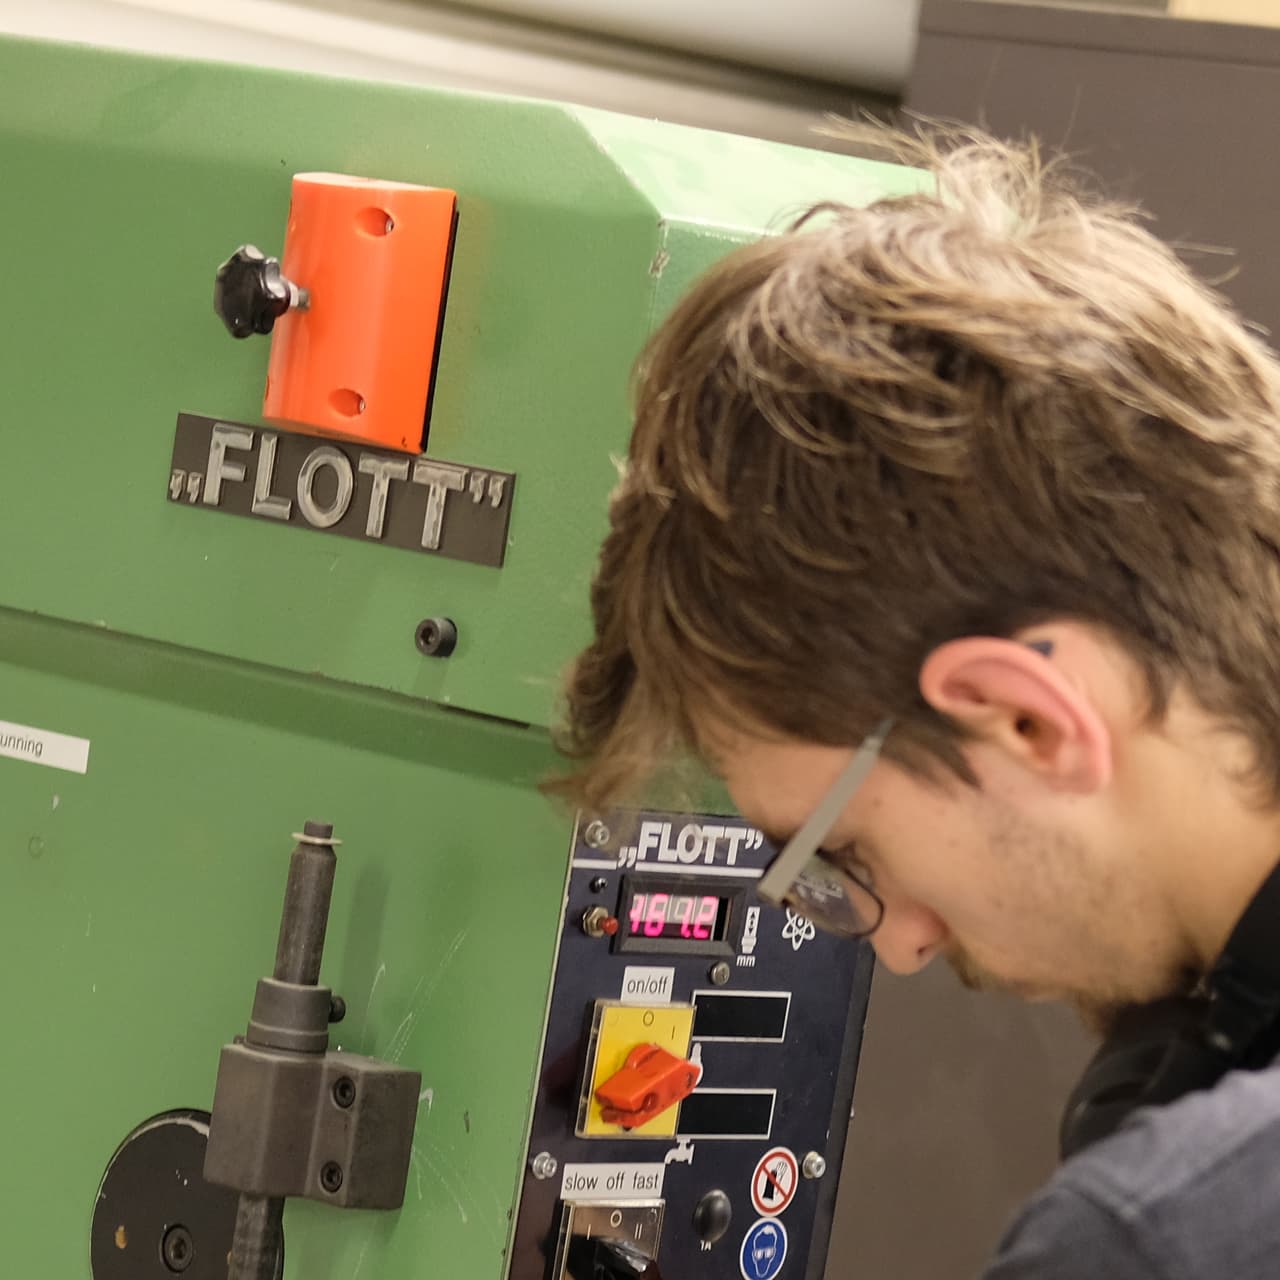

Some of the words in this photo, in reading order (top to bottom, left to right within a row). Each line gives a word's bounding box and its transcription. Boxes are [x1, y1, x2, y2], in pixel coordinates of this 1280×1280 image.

[736, 955, 755, 967] mm
[627, 975, 669, 994] on/off
[564, 1171, 599, 1191] slow
[606, 1171, 626, 1190] off
[632, 1171, 659, 1190] fast
